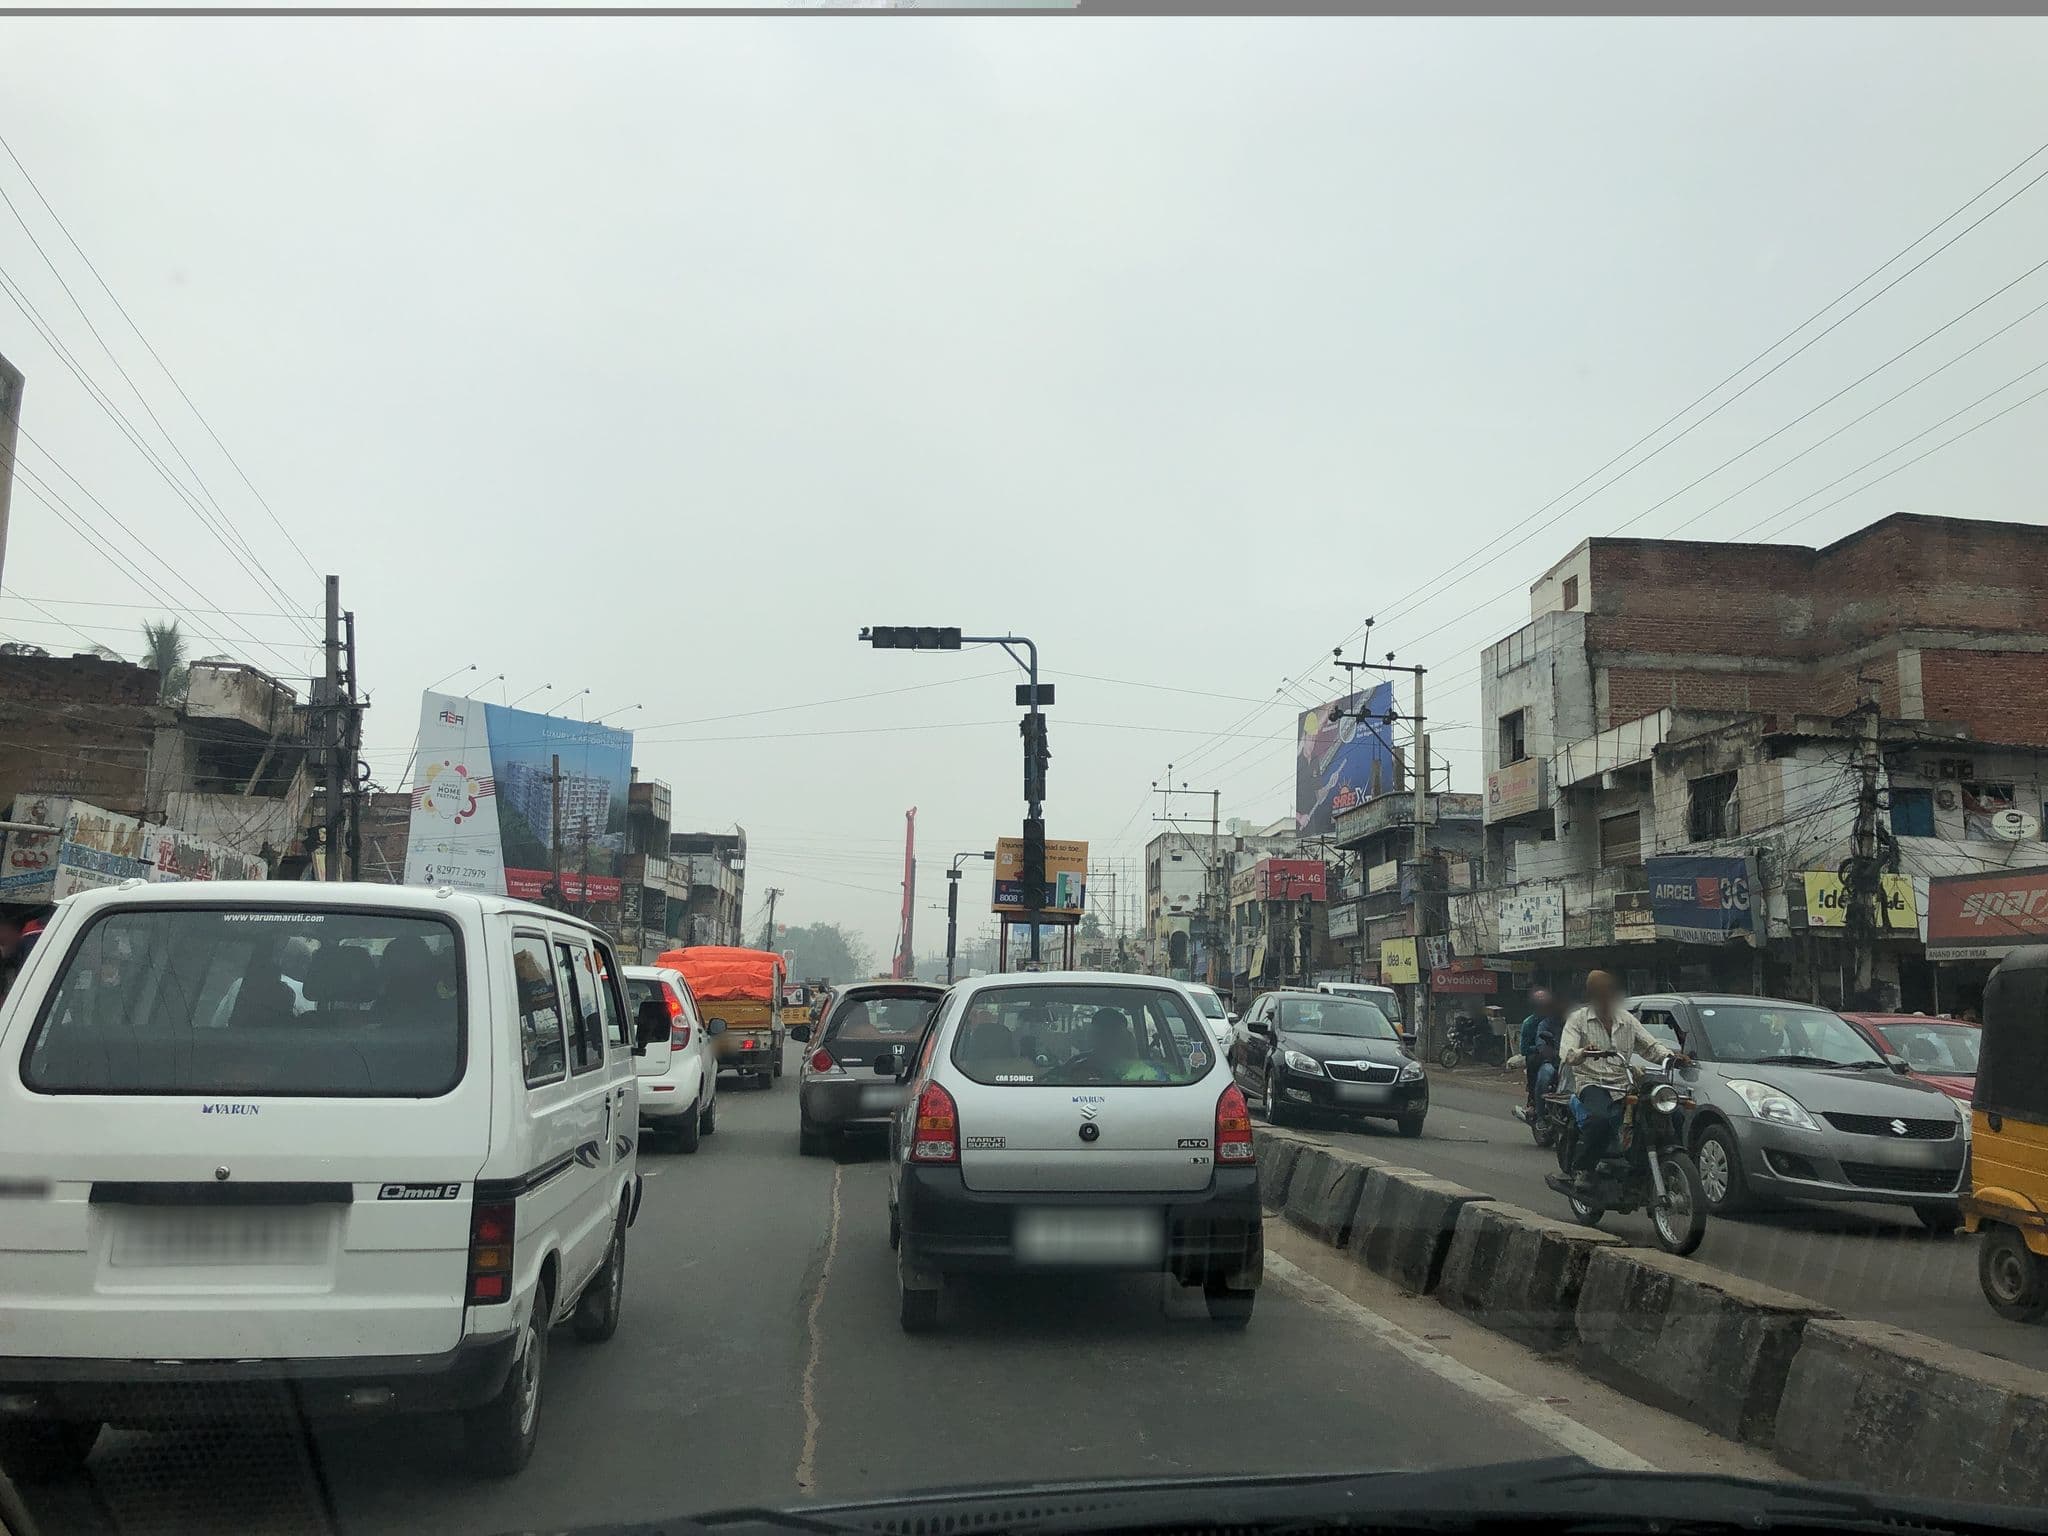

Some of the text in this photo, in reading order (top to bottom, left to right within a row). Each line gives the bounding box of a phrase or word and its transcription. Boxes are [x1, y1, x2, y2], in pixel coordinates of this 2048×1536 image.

[439, 786, 461, 795] HOME
[436, 792, 462, 800] FESTIVAL
[1332, 792, 1356, 808] SHREE
[436, 865, 486, 878] 82977 27979
[1308, 874, 1321, 882] 4G
[999, 894, 1018, 902] 8008
[1656, 878, 1750, 911] AIRCEL 3G
[224, 913, 325, 922] www.varunmaruti.com
[1929, 950, 1951, 958] ANAND
[1969, 949, 1987, 957] WEAR
[1404, 958, 1412, 966] 4G
[1446, 974, 1493, 985] vodafone
[215, 1104, 260, 1115] VARUN
[381, 1185, 459, 1198] Omni E
